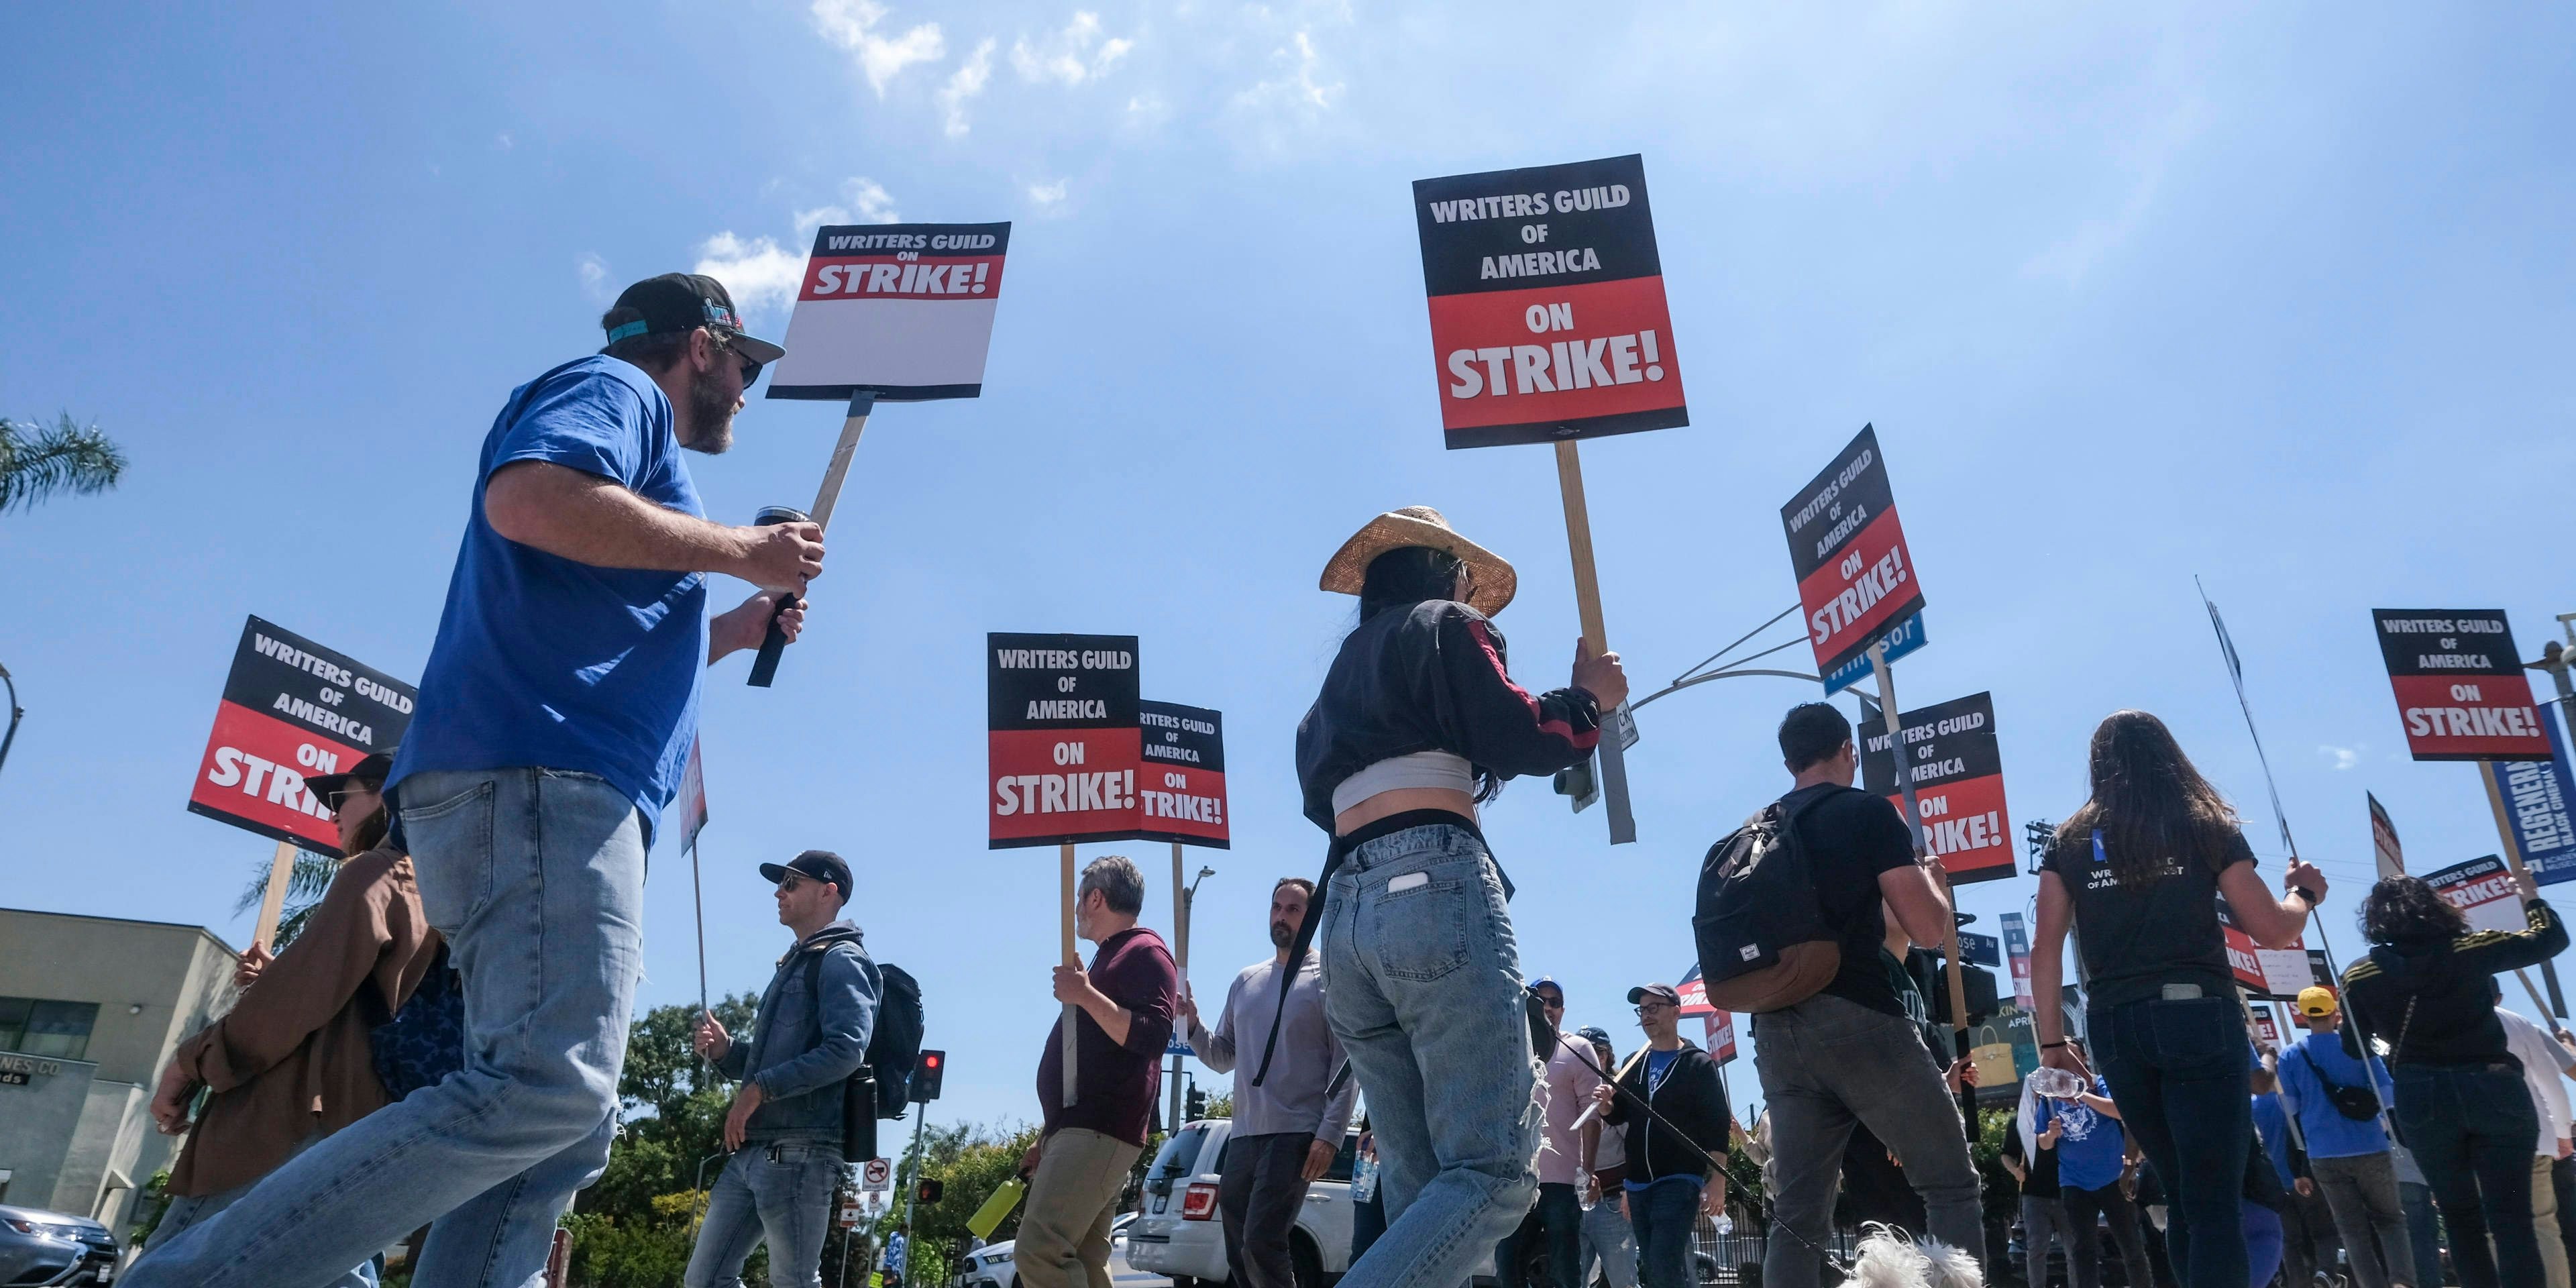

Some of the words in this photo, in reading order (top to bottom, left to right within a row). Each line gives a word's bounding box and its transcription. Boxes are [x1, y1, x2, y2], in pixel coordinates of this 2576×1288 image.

[1430, 193, 1549, 223] WRITERS
[1554, 184, 1630, 213] GUILD
[828, 235, 926, 250] WRITERS
[930, 234, 996, 250] GUILD
[1521, 224, 1548, 244] OF
[897, 251, 918, 261] ON
[1481, 248, 1601, 280] AMERICA
[813, 262, 990, 295] STRIKE!
[1525, 302, 1574, 333] ON
[1448, 329, 1664, 399] STRIKE!
[1789, 479, 1839, 533] WRITERS
[1838, 449, 1872, 488] GUILD
[1829, 500, 1841, 521] OF
[1816, 504, 1868, 559] AMERICA
[1841, 549, 1864, 580] ON
[1811, 545, 1907, 645] STRIKE!
[2382, 620, 2455, 633] WRITERS
[2456, 620, 2504, 633] GUILD
[2440, 638, 2457, 649] OF
[998, 649, 1079, 669] WRITERS
[1081, 650, 1132, 669] GUILD
[2418, 654, 2492, 668] AMERICA
[254, 633, 352, 688] WRITERS
[354, 677, 413, 714] GUILD
[1058, 676, 1076, 692] OF
[319, 687, 344, 706] OF
[2451, 684, 2482, 702] ON
[273, 692, 372, 745] AMERICA
[1026, 700, 1107, 720] AMERICA
[2406, 707, 2540, 737] STRIKE!
[1140, 711, 1179, 729] RITERS
[1182, 719, 1215, 735] GUILD
[1867, 723, 1935, 753] WRTERS
[1937, 712, 1984, 736] GUILD
[1165, 731, 1179, 743] OF
[297, 743, 338, 775] ON
[1053, 742, 1084, 765] ON
[1145, 744, 1200, 763] AMERICA
[1917, 744, 1934, 760] OF
[208, 746, 336, 822] STRI
[996, 769, 1136, 816] STRIKE!
[1165, 772, 1186, 789] ON
[1140, 790, 1222, 826] TRIKE!
[1919, 796, 1948, 818] ON
[2505, 761, 2561, 853] REGENERA
[1925, 810, 2002, 857] RIKE!
[2427, 871, 2465, 888] RITERS
[2464, 861, 2498, 876] GUILD
[1957, 936, 1976, 950] ose
[2008, 1016, 2031, 1028] APRI
[1707, 1024, 1733, 1055] STRIKE!
